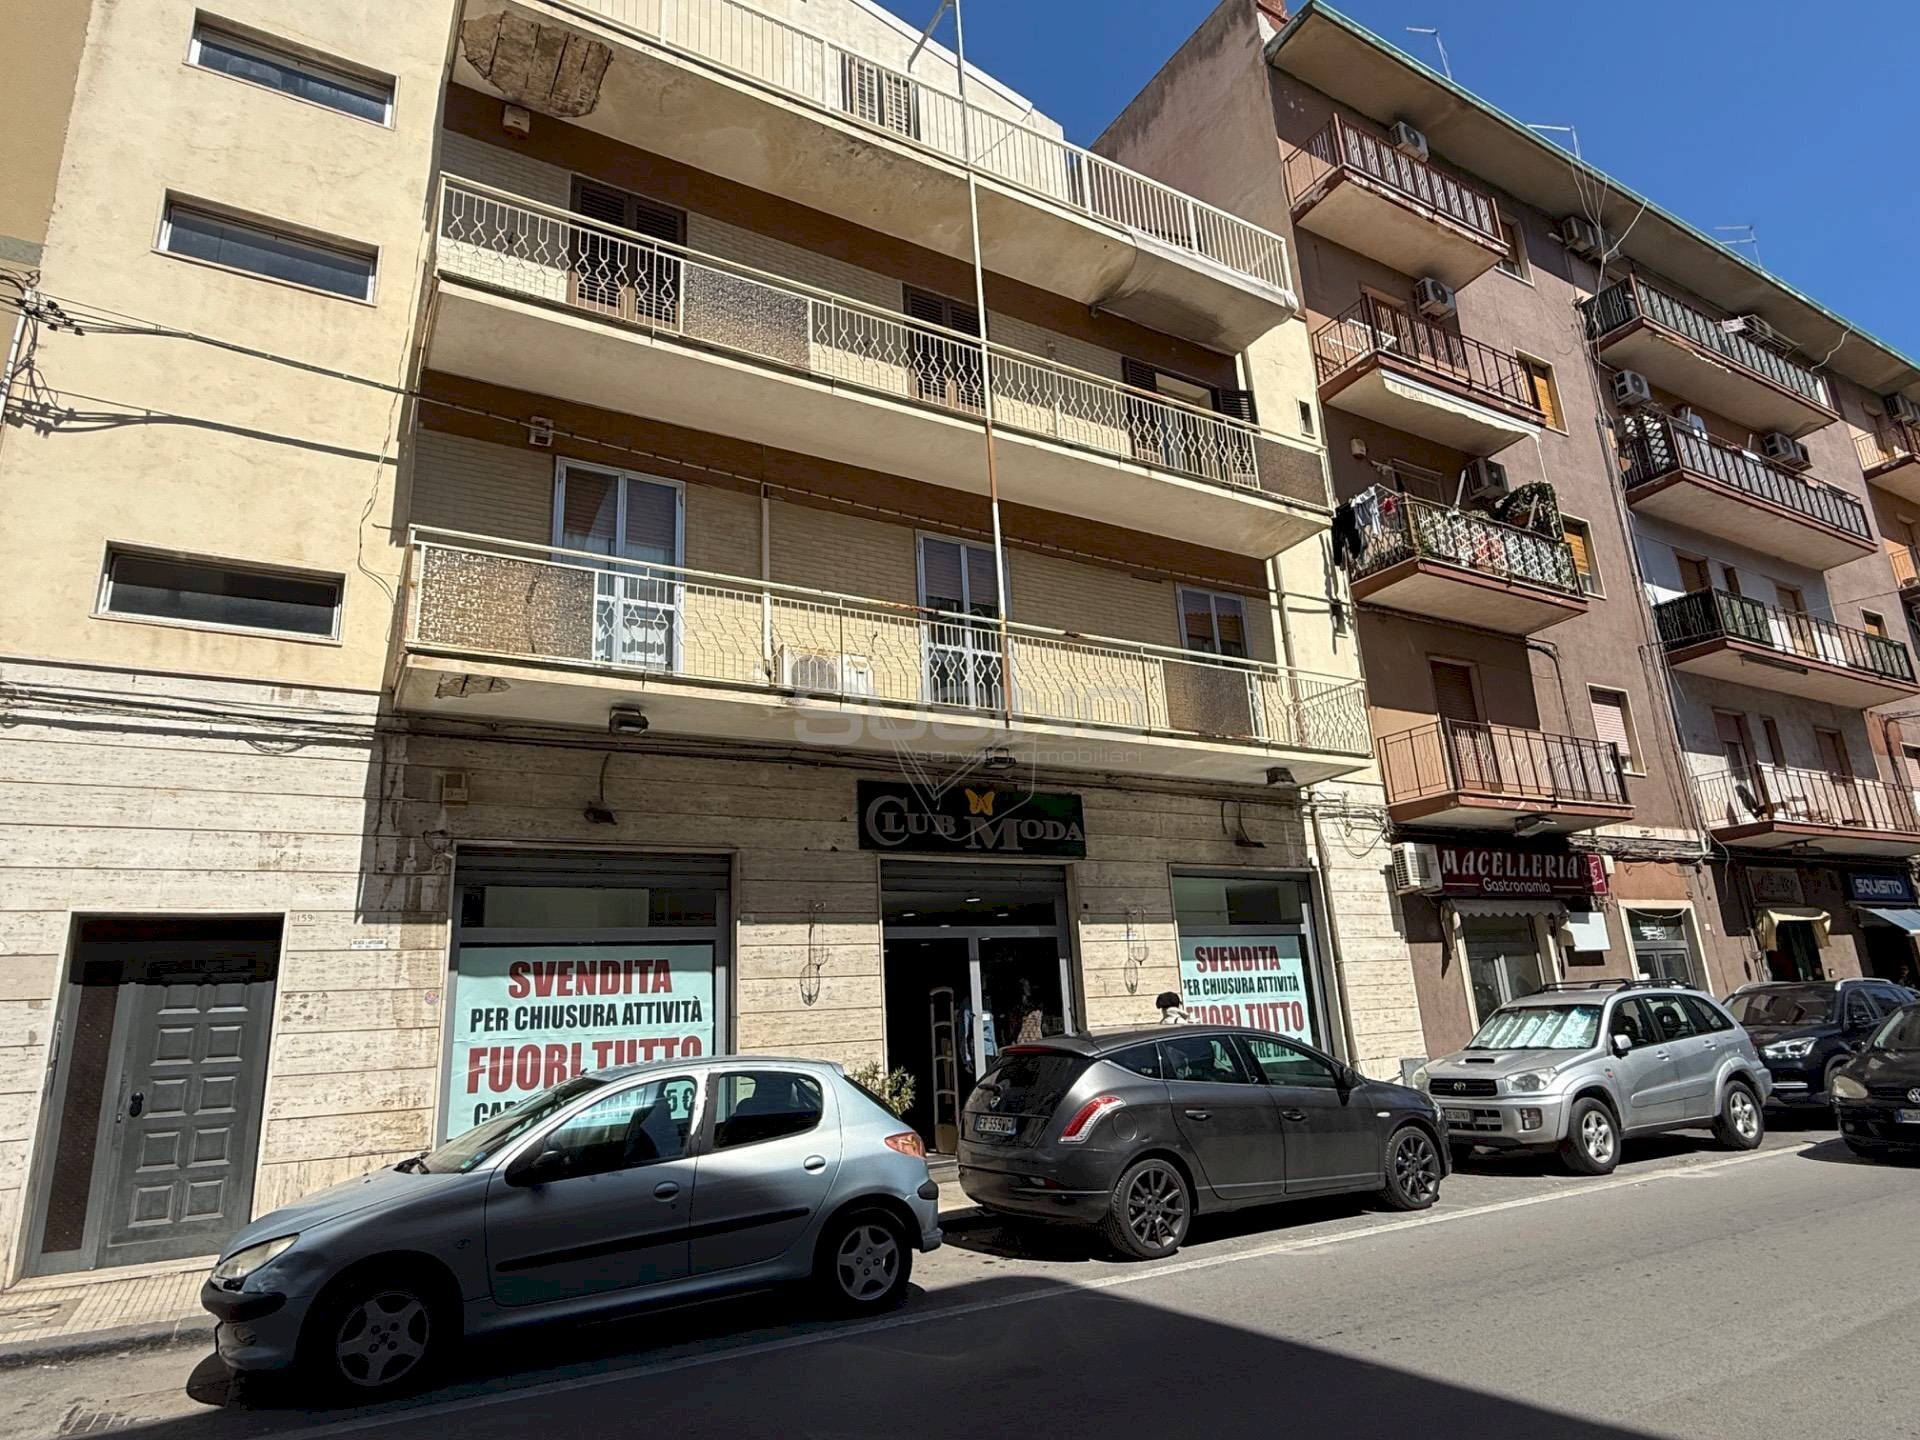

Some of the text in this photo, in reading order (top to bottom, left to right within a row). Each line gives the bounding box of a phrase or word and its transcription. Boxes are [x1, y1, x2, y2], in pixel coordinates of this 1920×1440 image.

[865, 795, 1084, 851] CLUB MODA
[1442, 849, 1579, 879] MACELLERIA
[1482, 877, 1551, 893] Gastronomia
[1855, 878, 1903, 895] SQUISITO
[1194, 945, 1281, 973] SVENDITA
[508, 959, 673, 999] SVENDITA
[1202, 976, 1255, 996] CHIUSURA
[1257, 972, 1300, 993] ATTIVITÀ
[470, 995, 703, 1033] PER CHIUSURA ATTIVITÀ
[1245, 1000, 1305, 1032] TUTTO
[467, 1042, 583, 1094] FUORI
